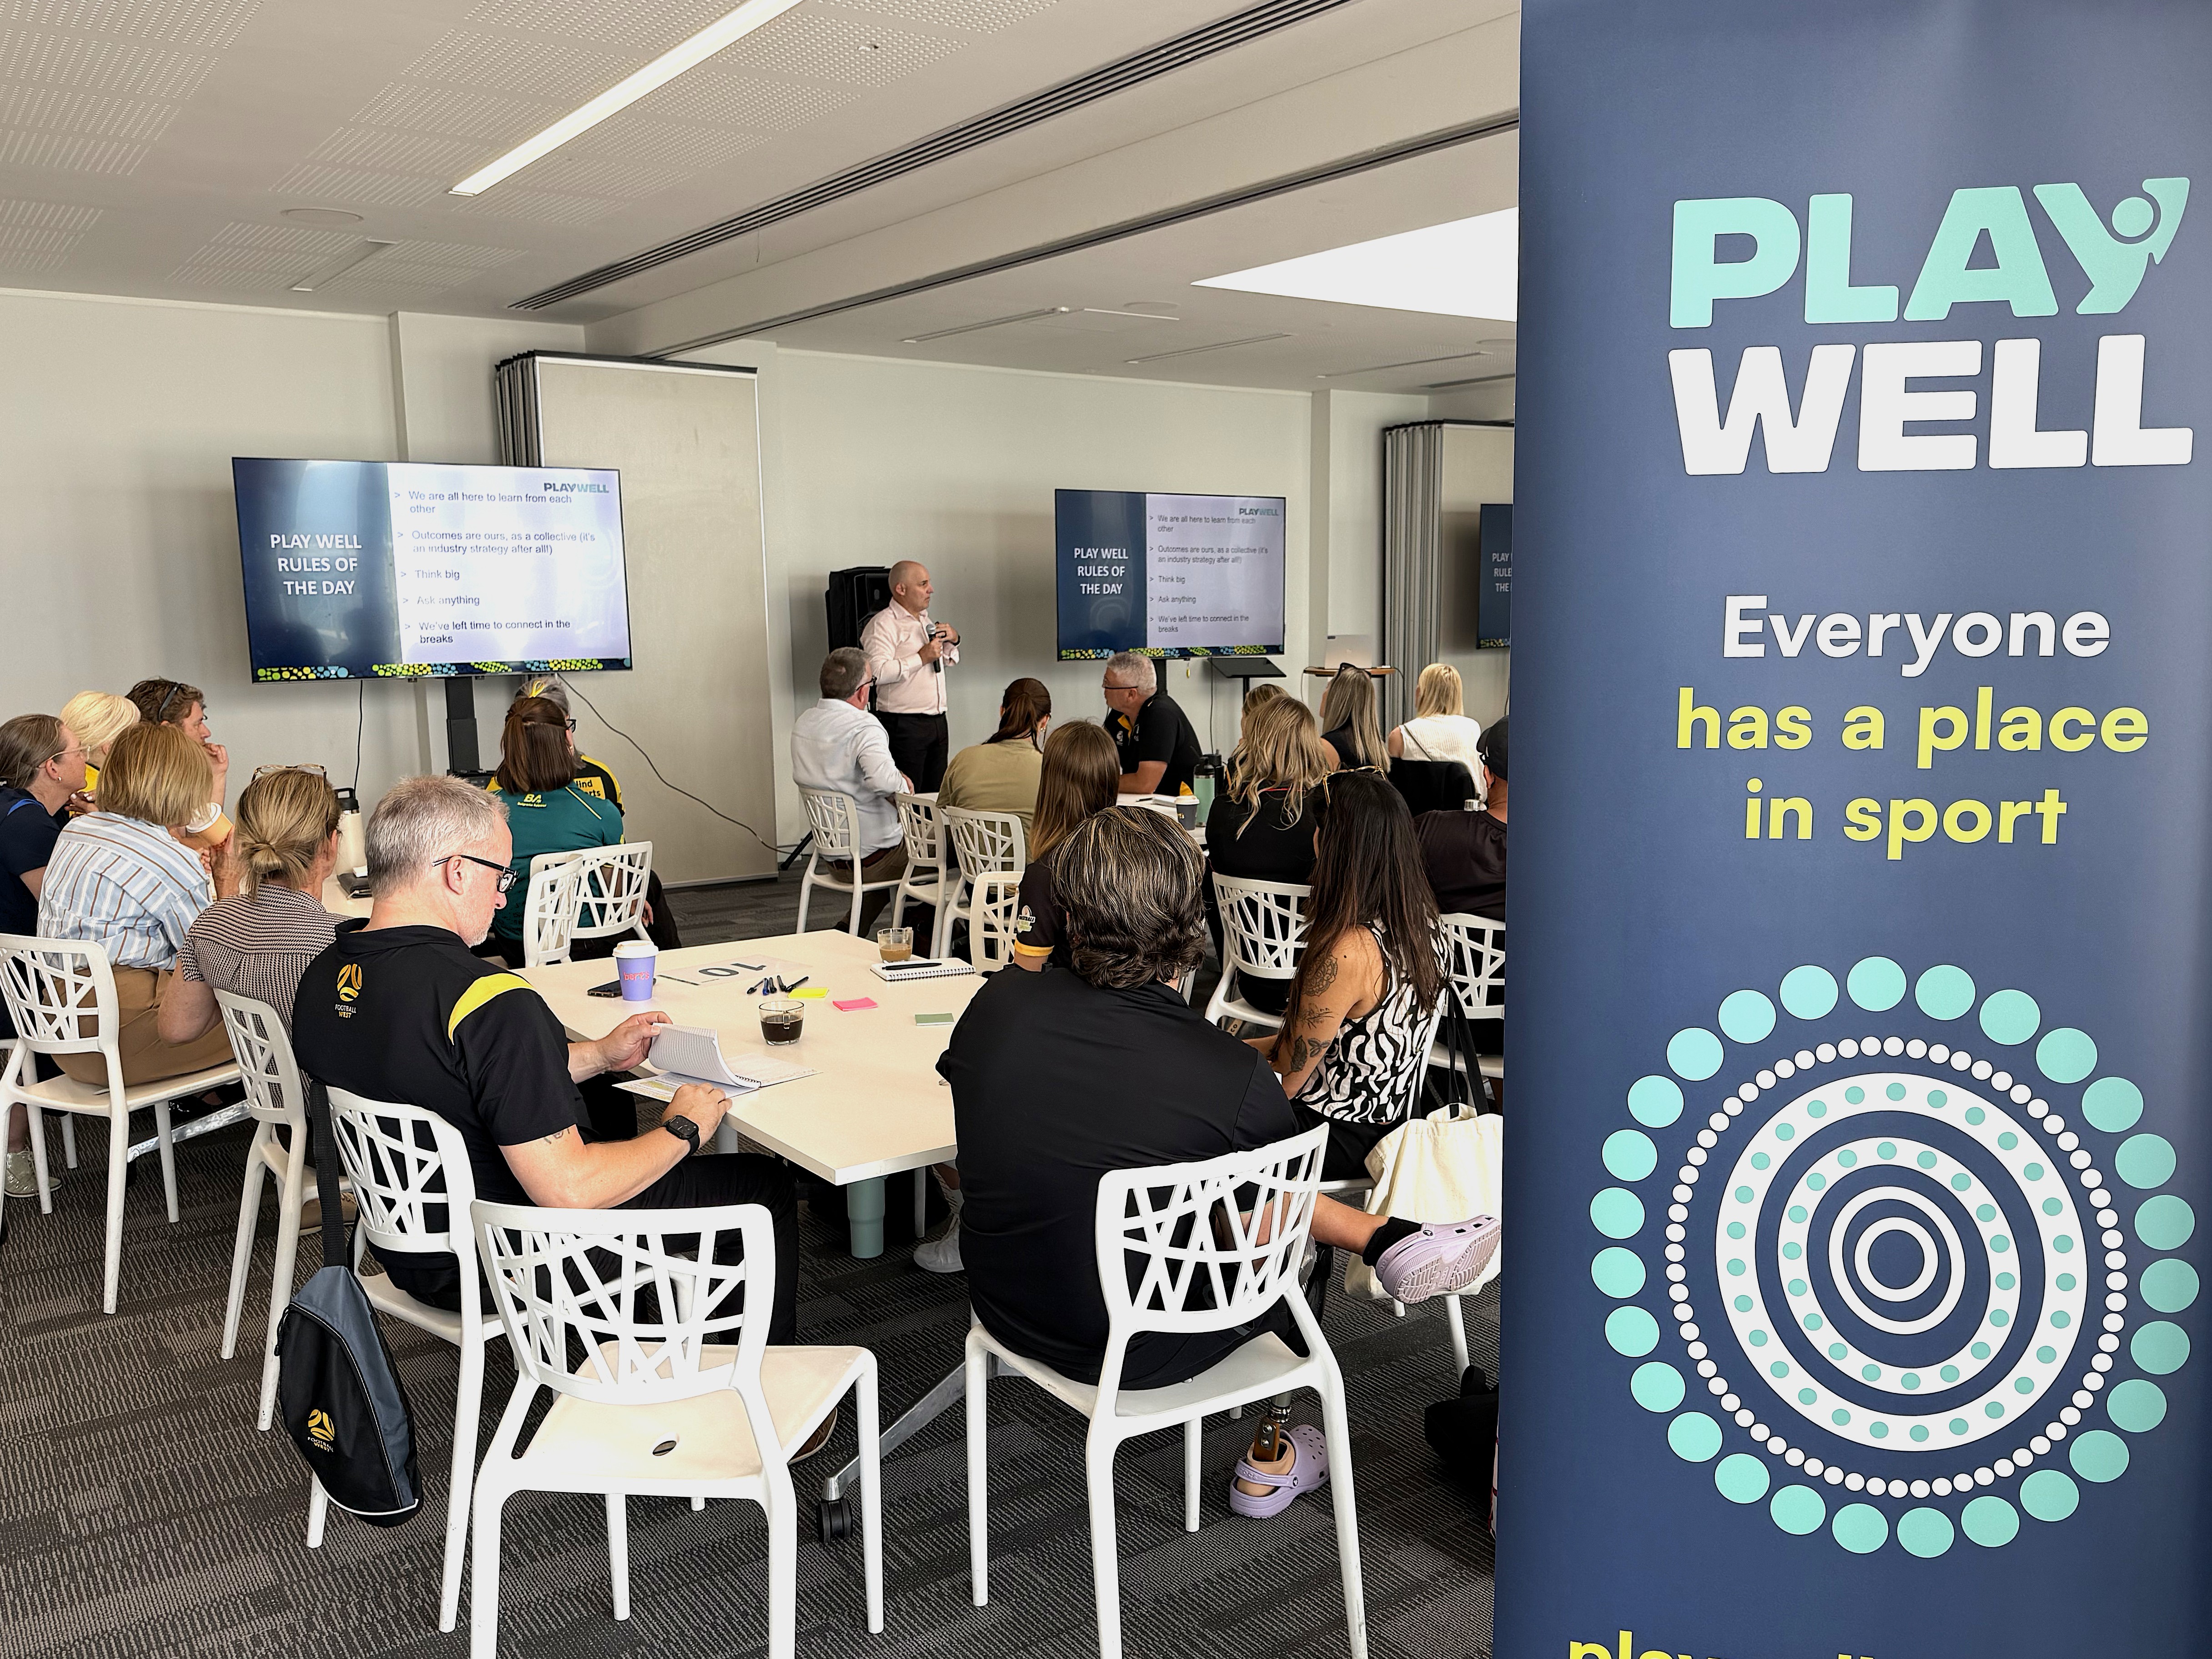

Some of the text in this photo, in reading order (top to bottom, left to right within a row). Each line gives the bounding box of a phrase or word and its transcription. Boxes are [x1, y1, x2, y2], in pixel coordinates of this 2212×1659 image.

[1671, 177, 2189, 327] PLAY
[1668, 334, 2194, 476] WELL
[408, 491, 425, 500] We
[447, 492, 458, 501] all
[462, 492, 483, 501] here
[487, 493, 496, 502] to
[498, 493, 523, 502] learn
[525, 493, 546, 503] from
[549, 494, 572, 503] each
[410, 504, 436, 513] other
[270, 534, 362, 549] PLAY WELL
[412, 530, 463, 540] Outcomes
[484, 533, 508, 541] ours,
[534, 532, 577, 541] collective
[579, 532, 596, 543] (it's
[428, 544, 467, 555] industry
[470, 544, 508, 555] strategy
[512, 544, 533, 553] after
[1074, 548, 1128, 559] PLAY WELL
[1167, 556, 1191, 564] industry
[1492, 553, 1509, 562] PLAY
[278, 557, 358, 572] RULES OF
[415, 569, 460, 581] Think big
[1077, 566, 1126, 577] RULES OF
[1494, 568, 1512, 577] RULE
[1176, 576, 1186, 584] big
[283, 580, 355, 595] THE DAY
[1080, 583, 1123, 594] THE DAY
[1495, 583, 1509, 592] THE
[417, 595, 480, 607] Ask anything
[1171, 596, 1196, 604] anything
[419, 619, 570, 631] We've left time to connect in the
[420, 634, 453, 644] breaks
[1723, 595, 2110, 678] Everyone
[1678, 687, 2148, 769] has a place
[576, 779, 593, 788] lind
[1745, 778, 2066, 860] in sport
[698, 963, 767, 977] 10
[335, 1004, 356, 1013] FOOTBALL
